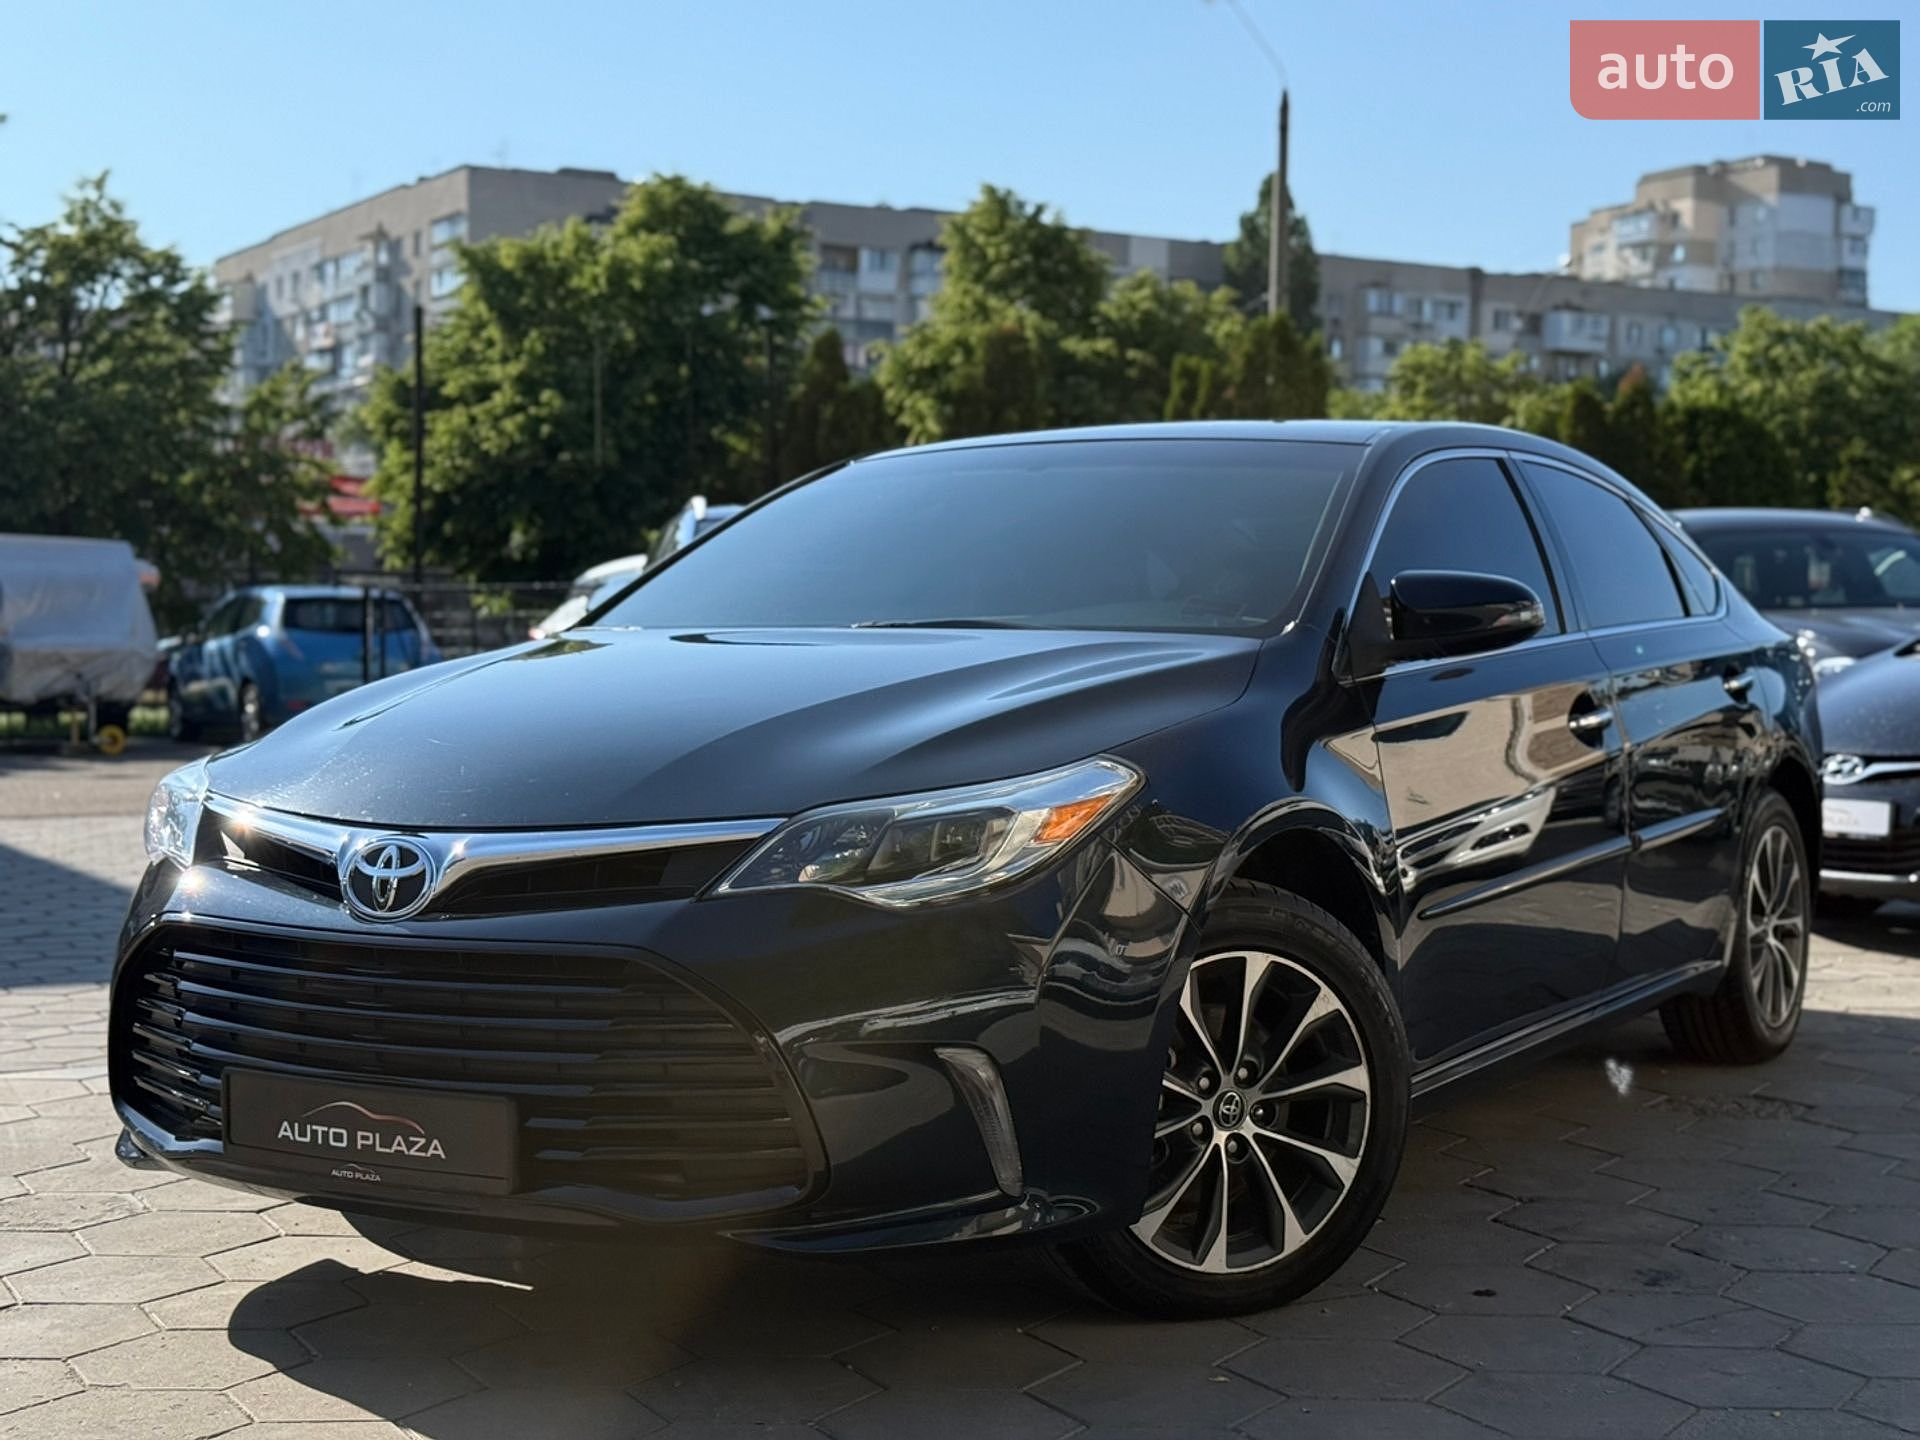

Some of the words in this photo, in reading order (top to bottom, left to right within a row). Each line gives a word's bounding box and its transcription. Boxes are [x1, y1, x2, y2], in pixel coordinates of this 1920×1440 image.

[278, 1121, 347, 1148] AUTO
[357, 1131, 446, 1159] PLAZA
[331, 1169, 354, 1179] AUTO
[355, 1172, 381, 1182] PLAZA
